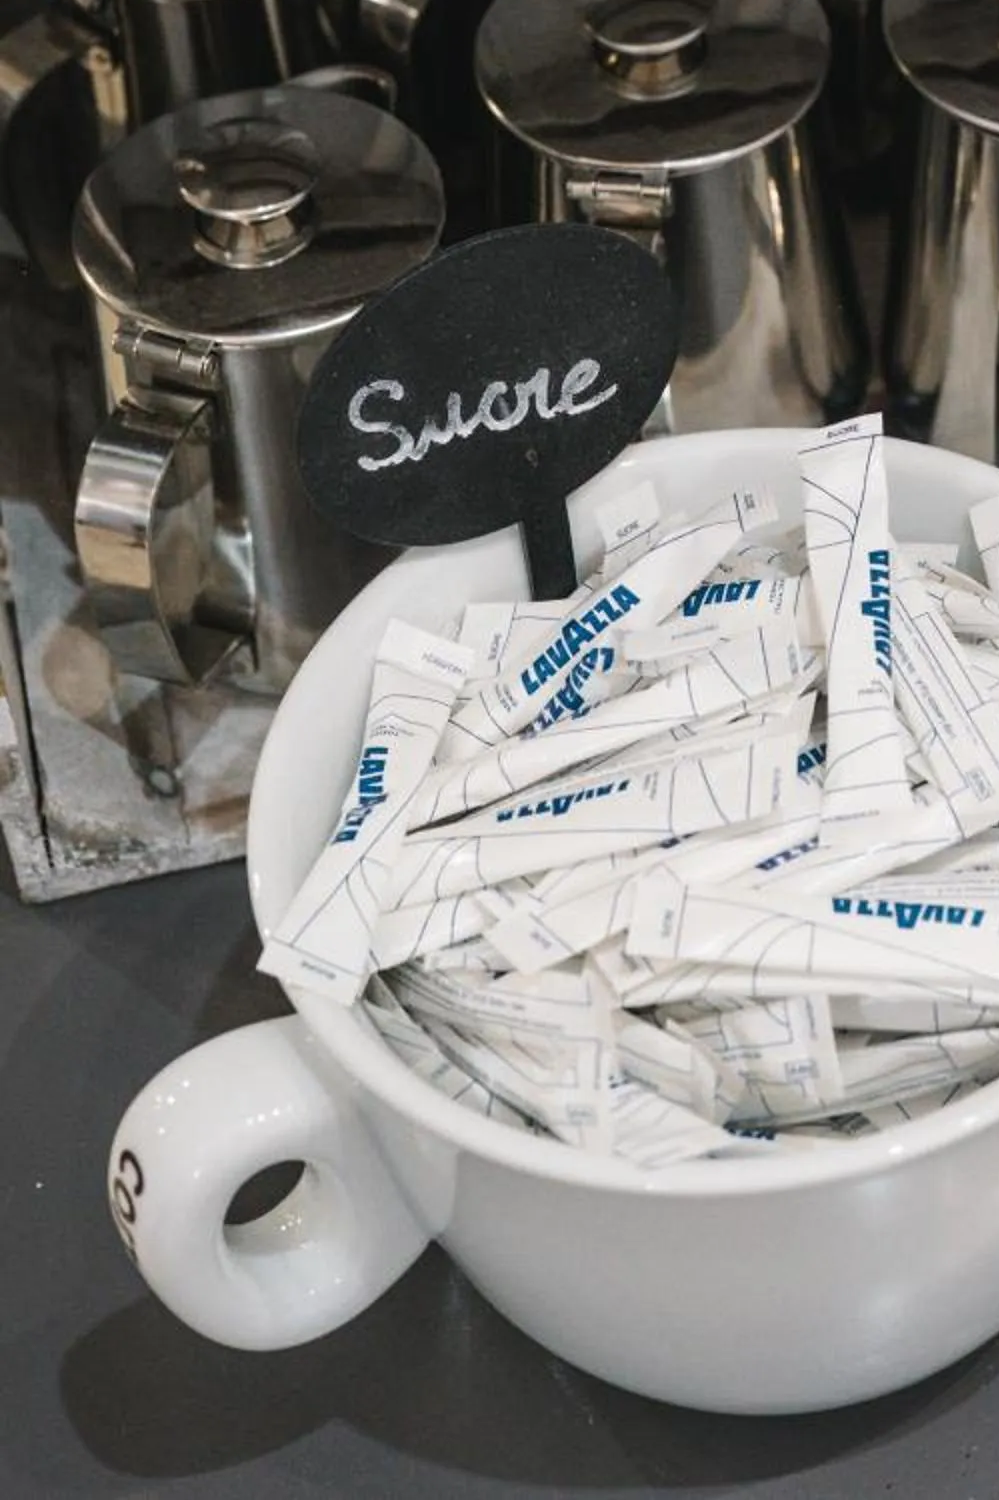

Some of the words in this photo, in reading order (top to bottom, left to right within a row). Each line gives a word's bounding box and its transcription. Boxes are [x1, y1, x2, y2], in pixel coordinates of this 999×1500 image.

[348, 358, 618, 472] Sucre
[519, 583, 641, 696] LAVAZZA
[682, 579, 761, 619] LAVA
[861, 548, 891, 679] LAVAZZA
